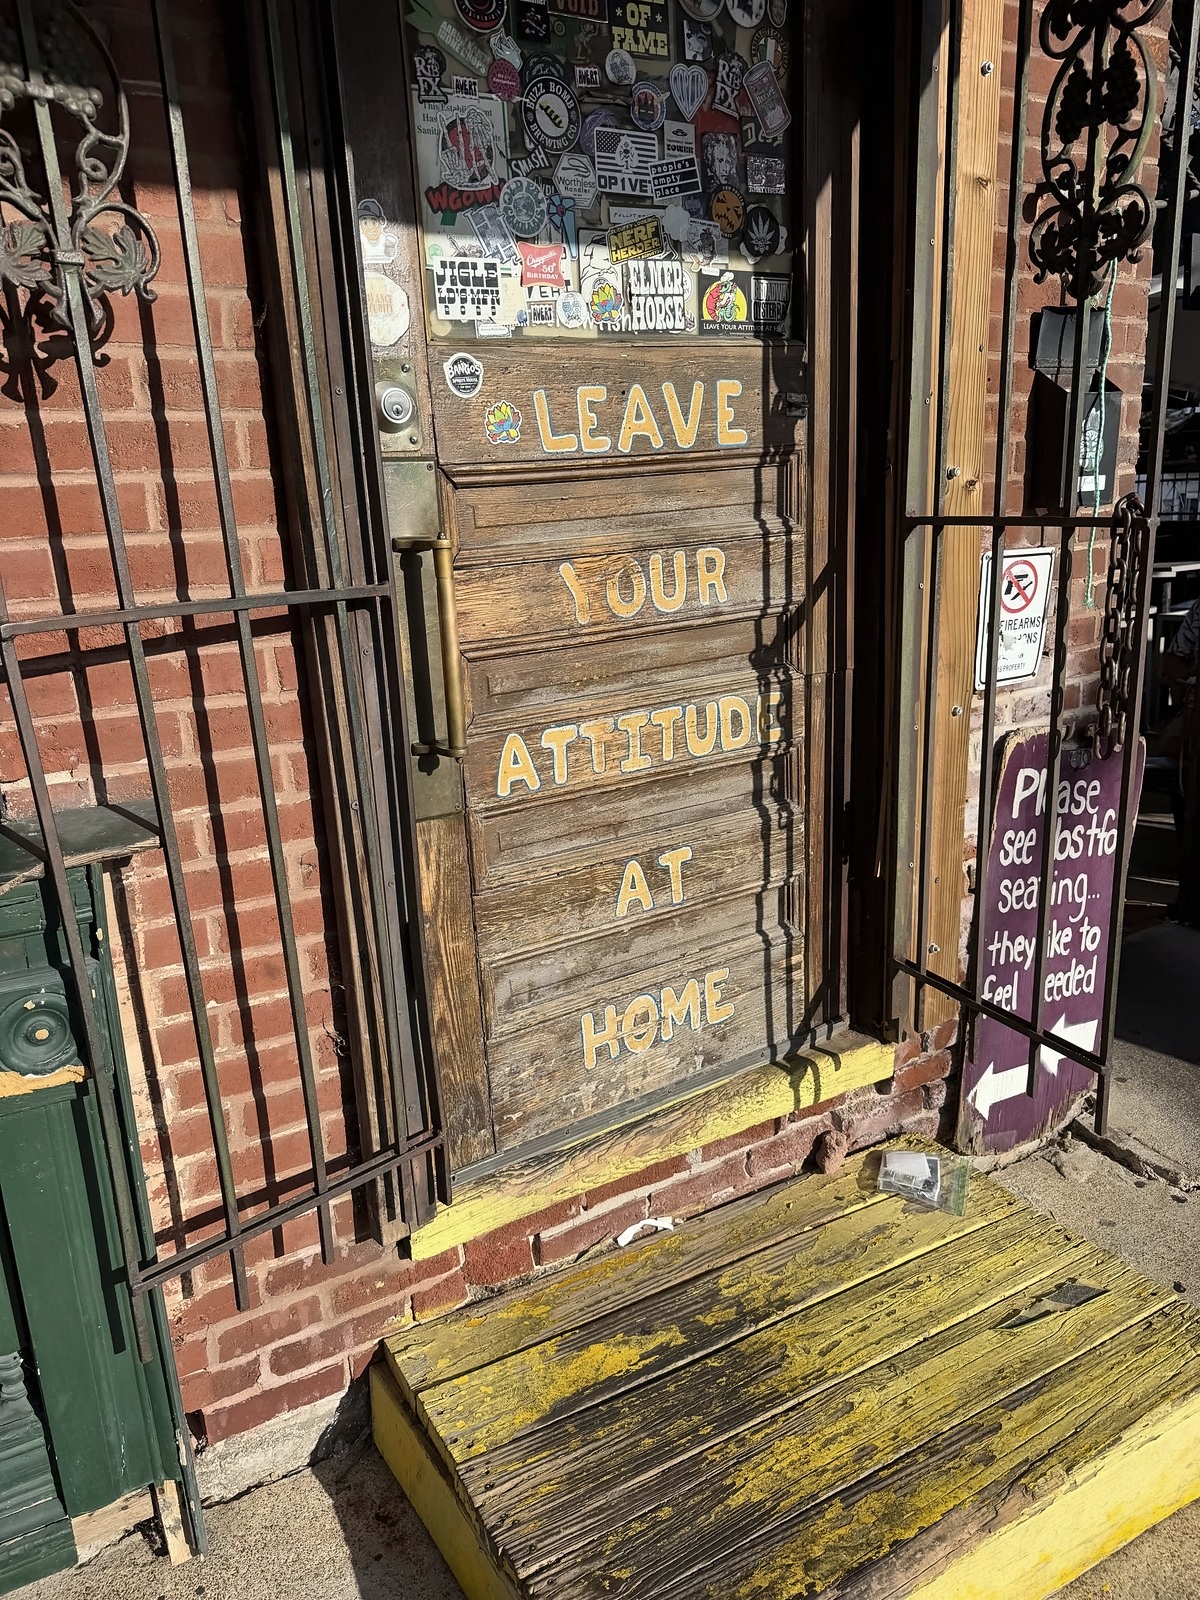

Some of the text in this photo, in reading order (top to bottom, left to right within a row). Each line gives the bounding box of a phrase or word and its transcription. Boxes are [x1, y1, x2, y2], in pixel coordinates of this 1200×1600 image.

[626, 2, 651, 28] OF
[612, 26, 669, 56] FAME
[527, 81, 575, 110] BUZZ BOMB
[422, 113, 438, 122] Has
[530, 122, 569, 149] BREWING
[511, 145, 549, 177] SMASH
[651, 161, 690, 175] people's
[556, 176, 596, 188] Worthless
[565, 185, 591, 194] Handler
[653, 173, 682, 186] empty
[655, 186, 680, 197] place
[610, 221, 658, 251] NERF
[611, 237, 660, 262] HERDER
[526, 271, 559, 280] BIRTHDAY
[627, 260, 684, 295] ELMER
[533, 306, 553, 322] AVERT
[631, 295, 685, 330] HORSE
[753, 301, 777, 321] OYSTER
[703, 322, 720, 330] LEAVE
[532, 379, 748, 453] LEAVE
[559, 547, 729, 625] YOUR
[999, 616, 1041, 631] FIREARMS
[1003, 663, 1026, 672] PROPERTY
[497, 692, 785, 798] ATTITUDE
[1011, 767, 1101, 819] Plase
[999, 828, 1037, 867] see
[1053, 813, 1101, 861] ost
[614, 845, 694, 919] AT
[998, 870, 1100, 923] seaing...
[987, 916, 1101, 971] they ike to
[981, 954, 1098, 1019] feel eeded
[580, 966, 736, 1071] HOME
